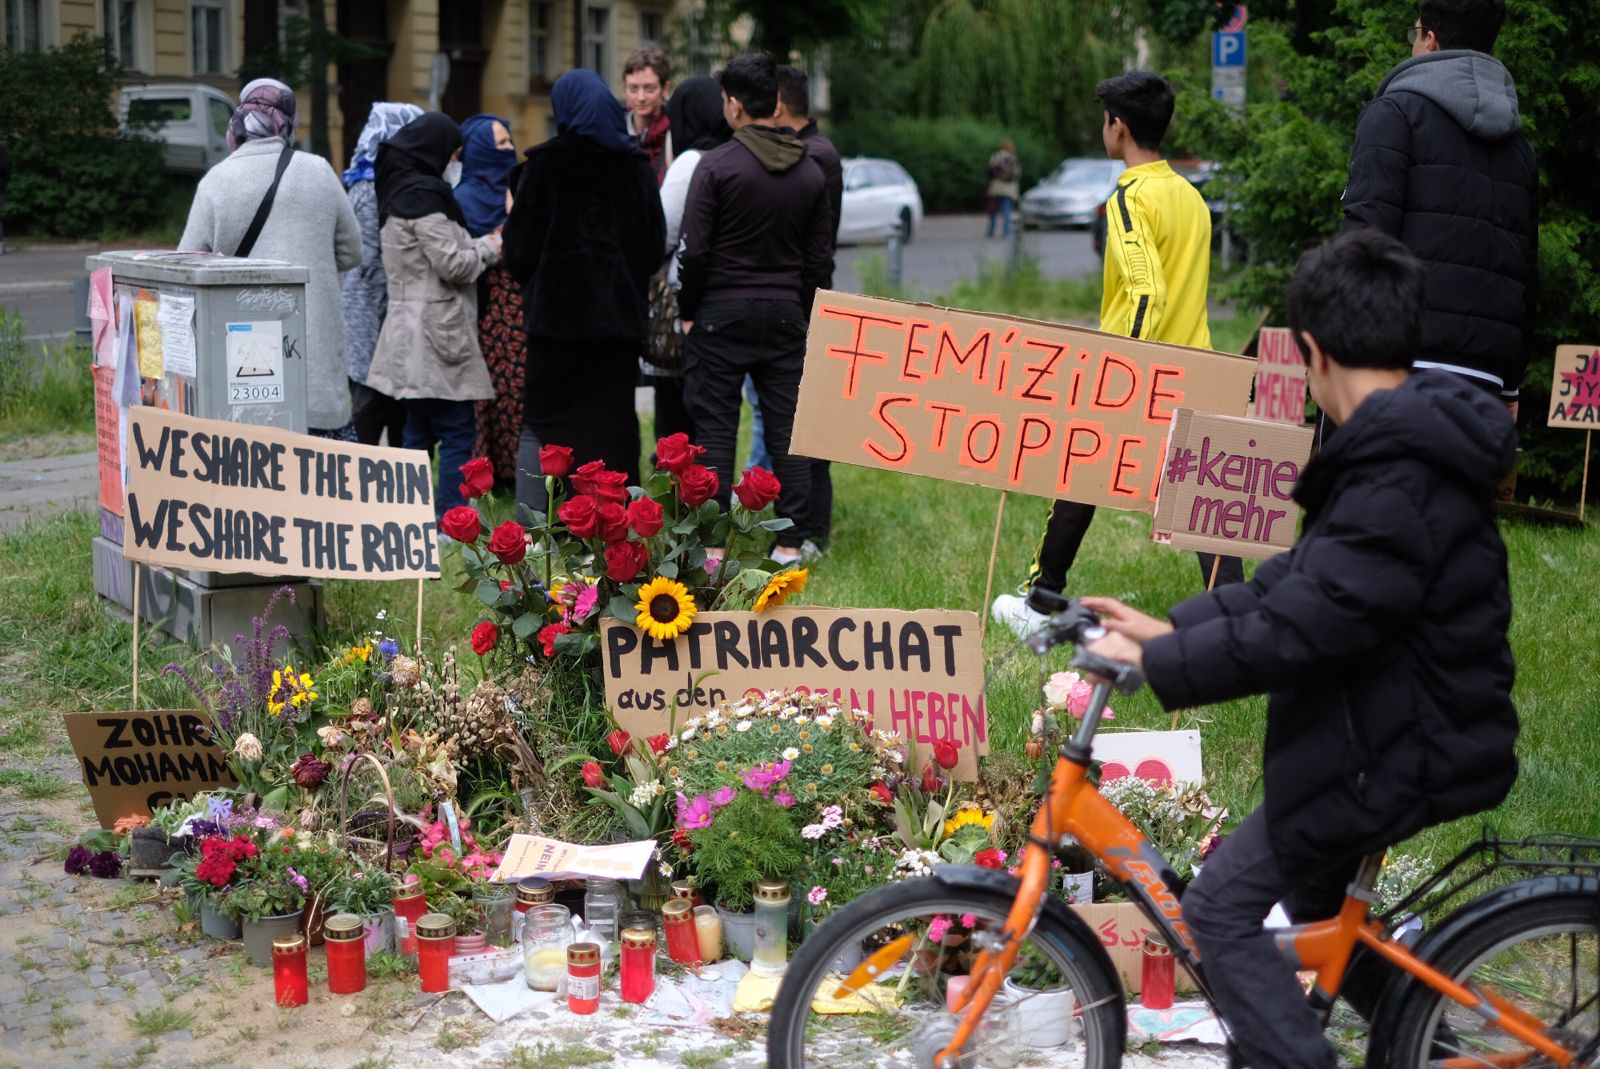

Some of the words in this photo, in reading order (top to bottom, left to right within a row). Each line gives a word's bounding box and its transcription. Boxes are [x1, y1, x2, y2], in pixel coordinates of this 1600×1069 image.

[1220, 36, 1240, 64] P
[1575, 354, 1600, 375] JI
[233, 386, 279, 400] 23004
[1559, 376, 1600, 398] JÎY
[1551, 402, 1600, 423] AZA
[293, 447, 353, 500] THE
[359, 456, 431, 505] PAIN
[1167, 436, 1300, 501] #keine
[1189, 495, 1287, 542] mehr
[294, 517, 358, 571] THE
[361, 521, 440, 572] RAGE
[607, 616, 962, 678] PATRIARCHAT
[617, 688, 665, 711] aus
[676, 671, 725, 708] den
[889, 687, 986, 749] HEBEN
[97, 714, 218, 748] ZOHR
[83, 751, 239, 786] MOHAMM
[534, 844, 556, 870] NEIN
